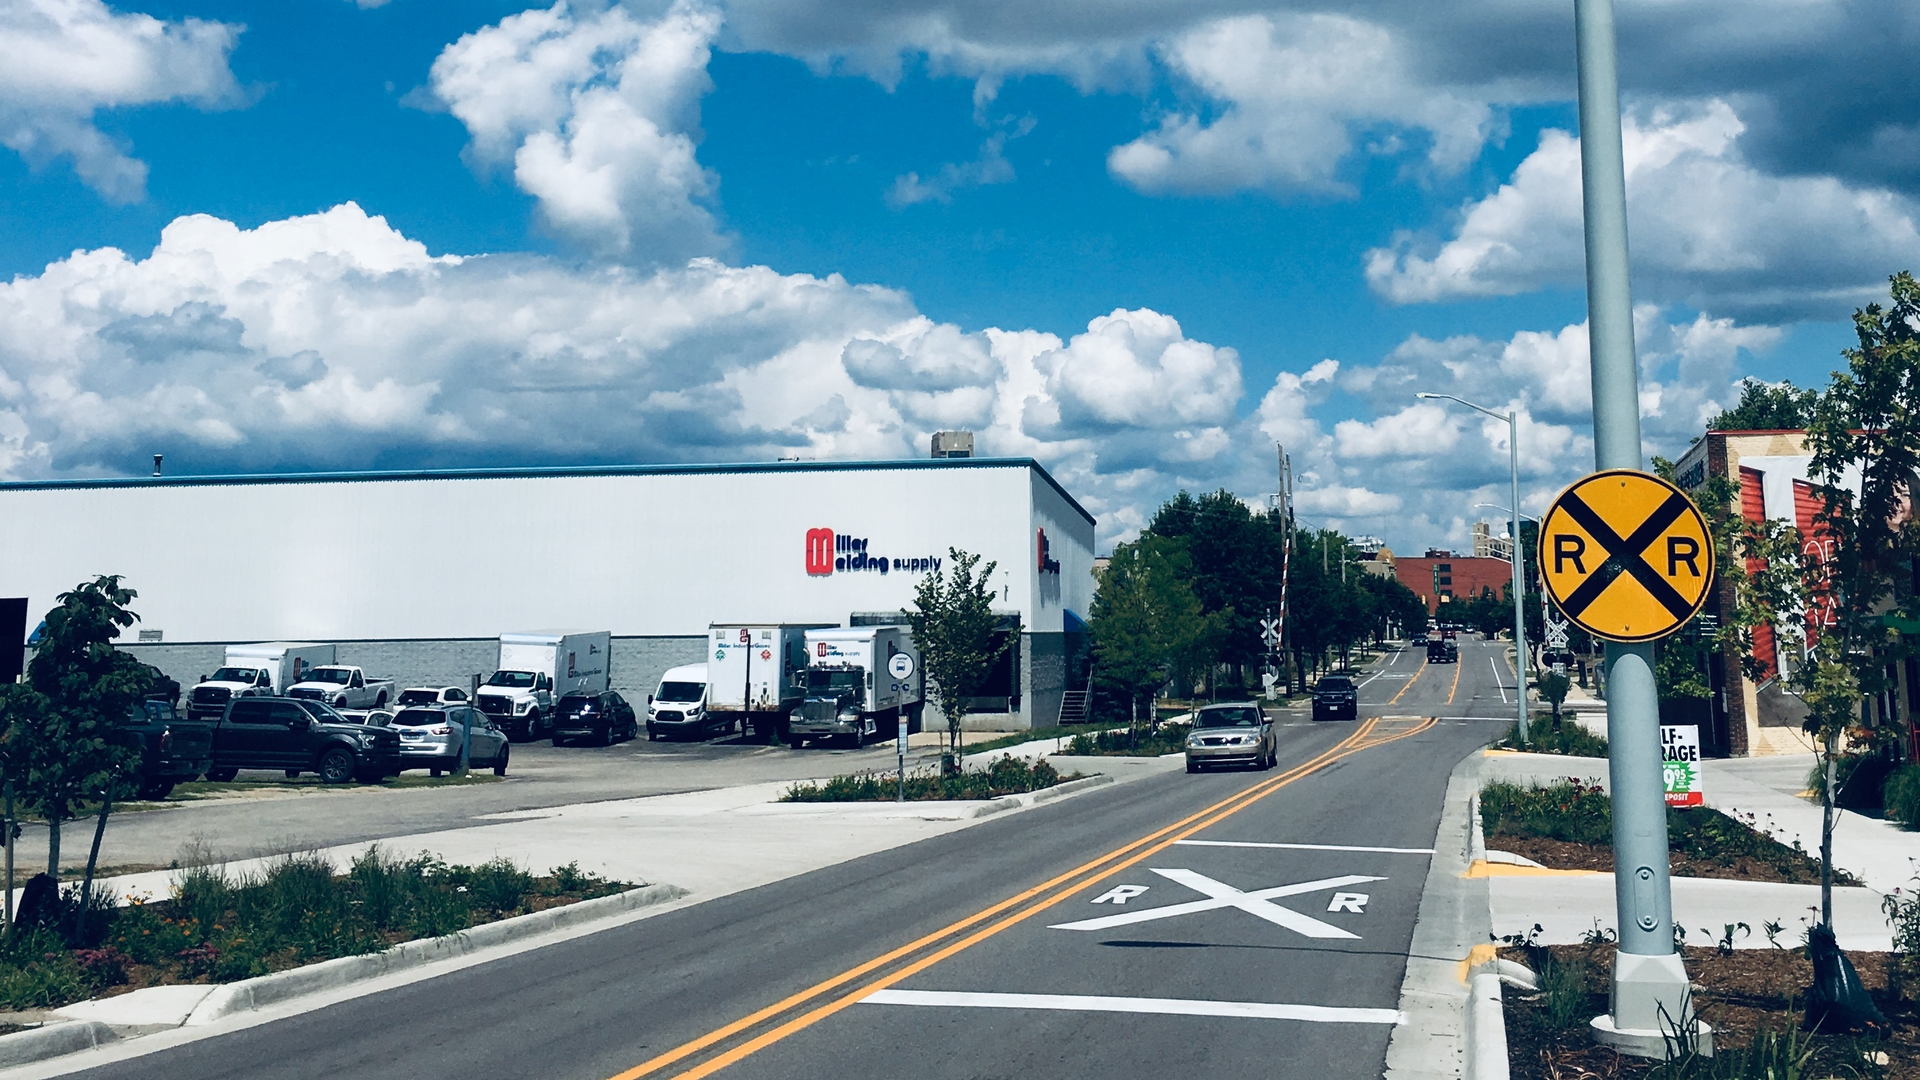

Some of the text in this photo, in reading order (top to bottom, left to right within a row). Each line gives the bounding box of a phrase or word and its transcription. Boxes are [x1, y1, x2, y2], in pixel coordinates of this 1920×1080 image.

[893, 555, 941, 573] supply
[1554, 534, 1701, 577] R R
[1661, 728, 1682, 744] LF-
[1661, 745, 1697, 761] RAGE
[1664, 793, 1688, 801] EPOSIT
[1090, 884, 1370, 914] R R
